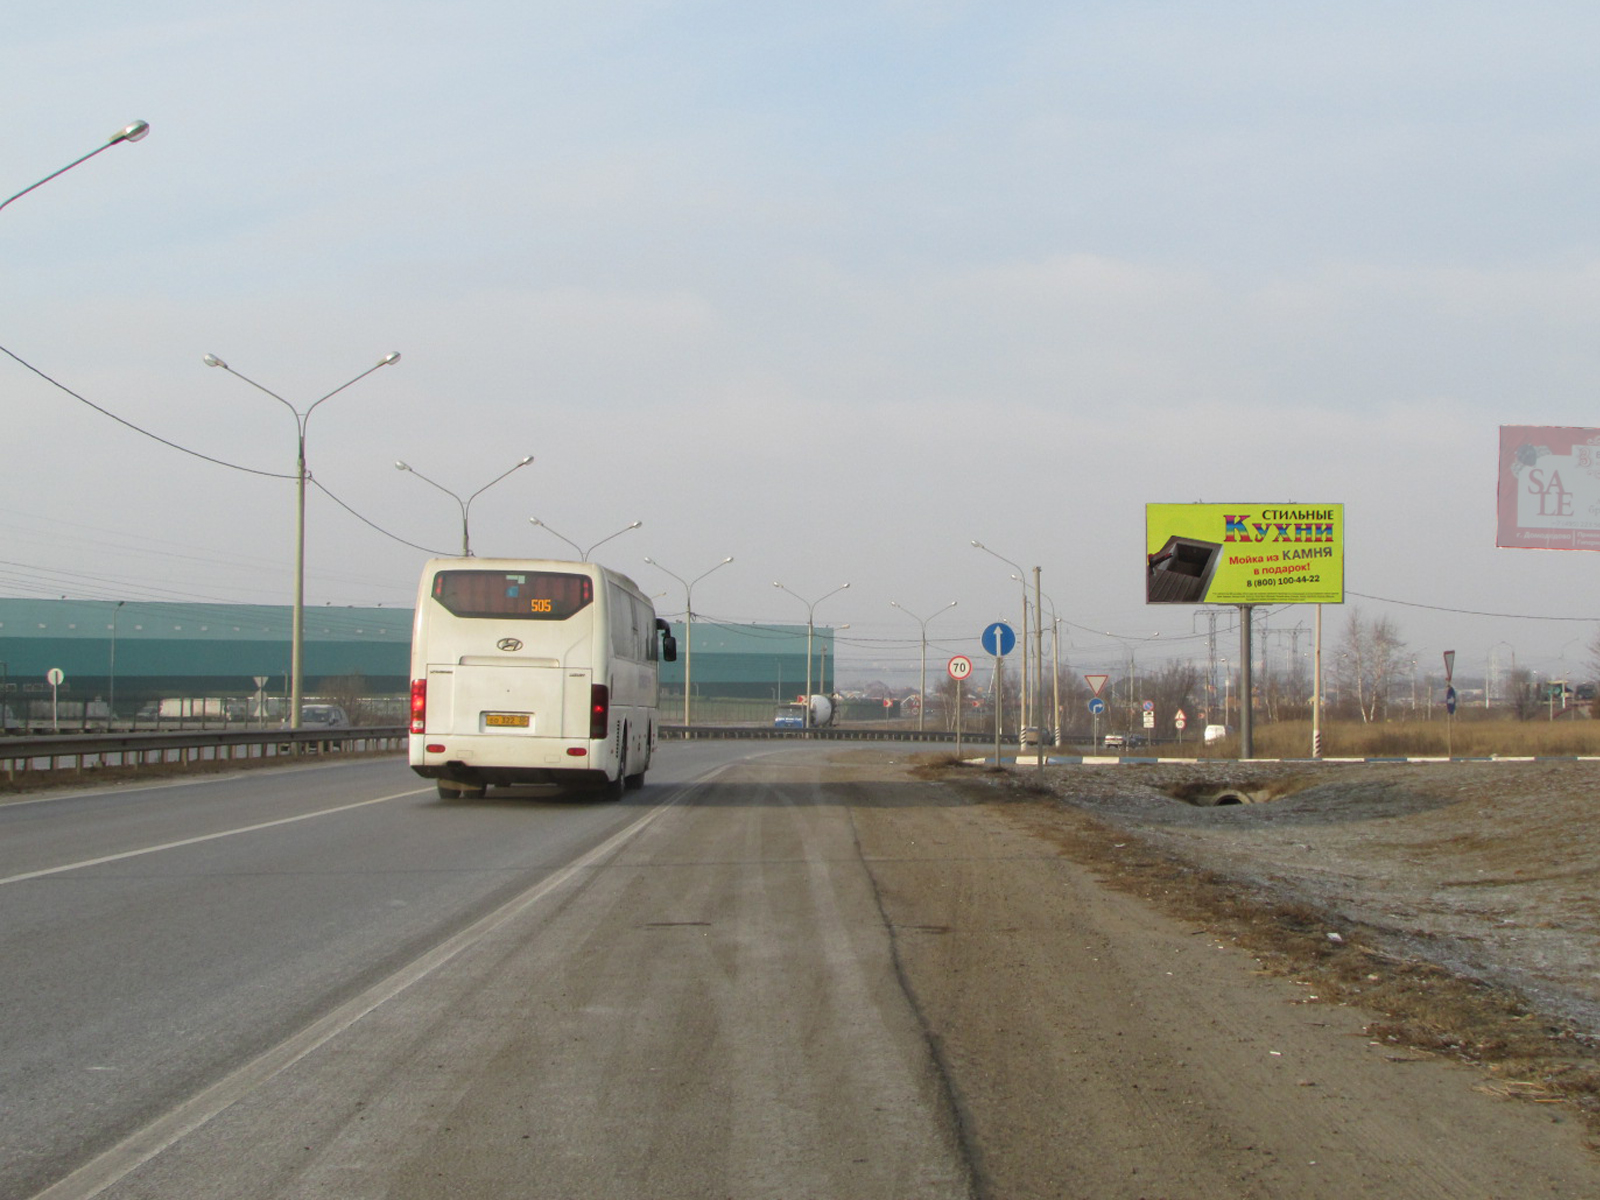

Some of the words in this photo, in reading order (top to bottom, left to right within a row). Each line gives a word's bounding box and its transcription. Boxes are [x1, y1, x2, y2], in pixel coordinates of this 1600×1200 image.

[1262, 509, 1334, 521] СТИЛЬНЫЕ
[1523, 531, 1572, 541] Домодедово
[1229, 553, 1264, 565] Мойка
[1267, 554, 1279, 563] из
[1282, 546, 1332, 561] КАМНЯ
[1253, 568, 1259, 576] в
[1262, 562, 1311, 575] подарок!
[1246, 579, 1252, 587] 8
[1254, 577, 1277, 588] (800)
[1278, 574, 1320, 585] 100-44-22
[531, 598, 552, 612] 505
[953, 662, 966, 673] 70
